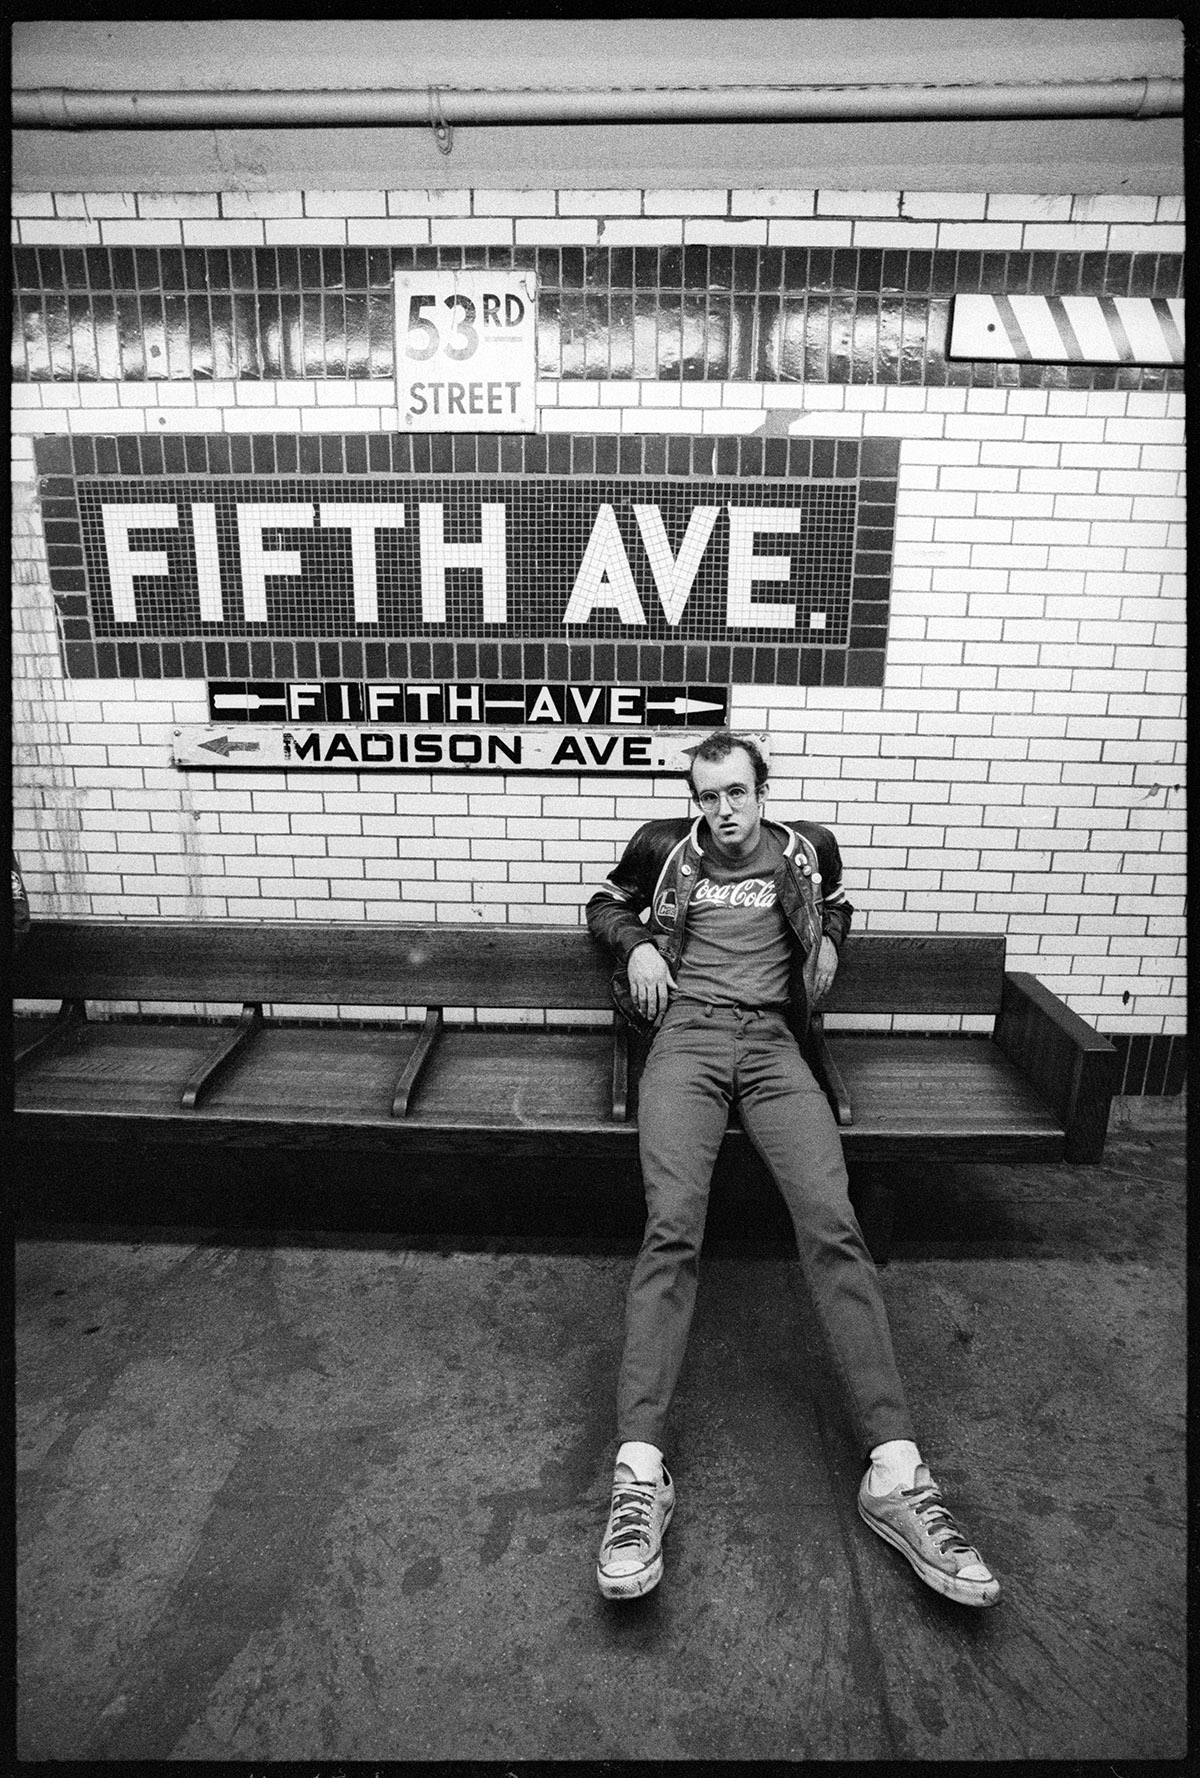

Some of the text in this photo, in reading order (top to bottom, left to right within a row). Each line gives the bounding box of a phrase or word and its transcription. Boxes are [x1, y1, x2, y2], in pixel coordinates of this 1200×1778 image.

[406, 293, 525, 361] 53RD
[410, 381, 521, 415] STREET
[101, 502, 826, 628] FIFTH AVE.
[289, 684, 643, 724] FIFTH AVE
[283, 733, 665, 766] MADISON AVE.
